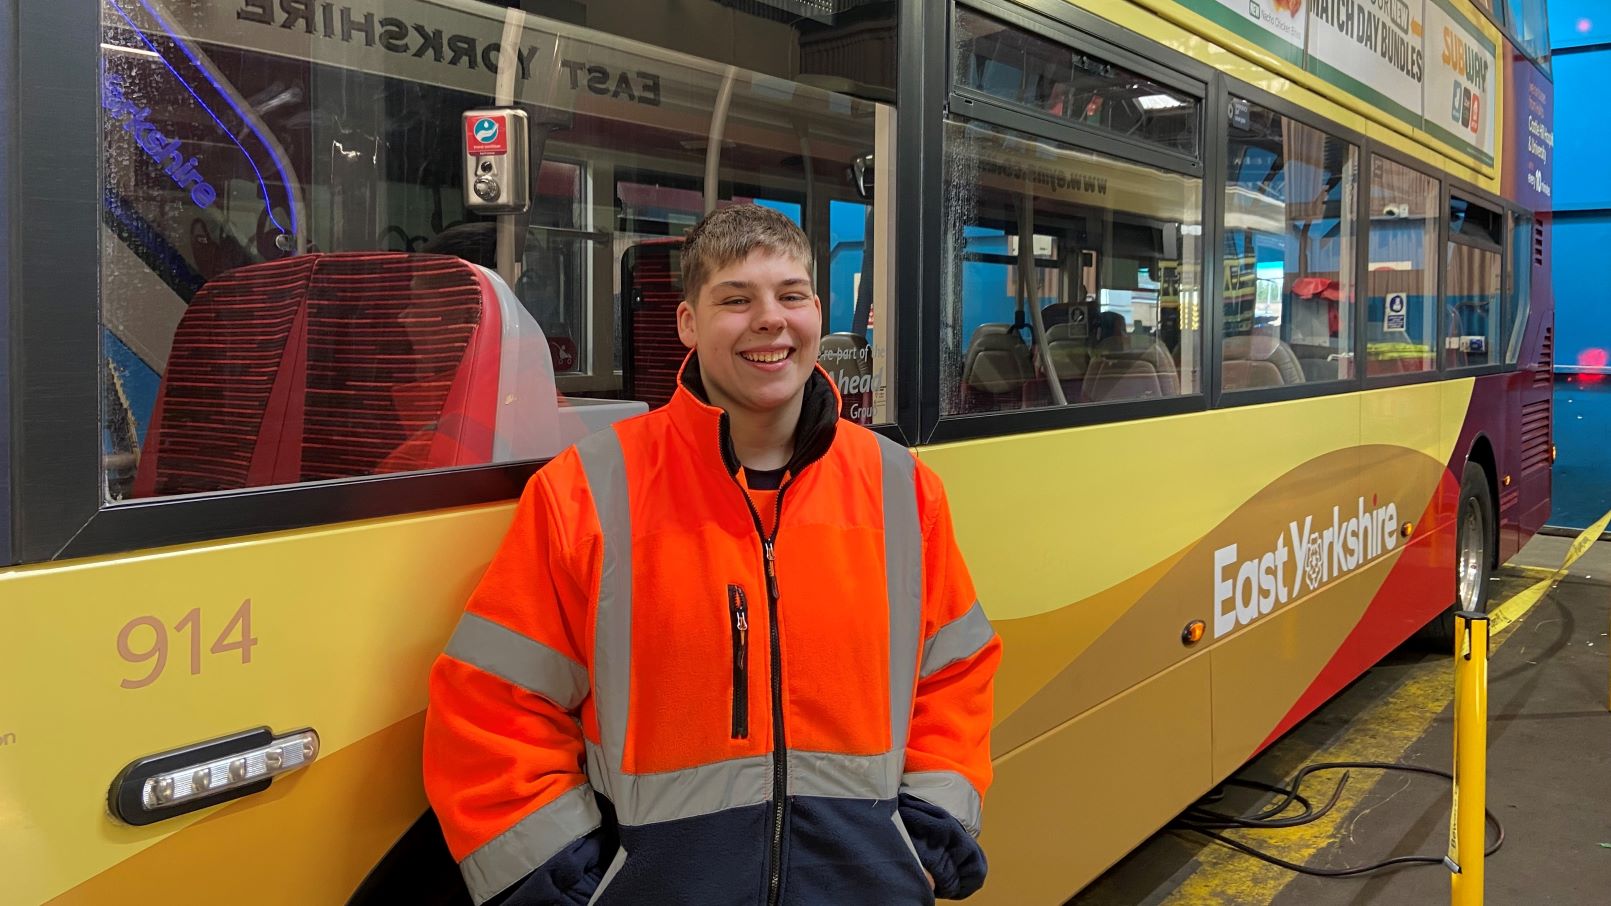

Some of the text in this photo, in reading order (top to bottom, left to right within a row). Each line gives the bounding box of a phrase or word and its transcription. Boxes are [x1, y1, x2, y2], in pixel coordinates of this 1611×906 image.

[1390, 0, 1408, 33] NEW
[1357, 3, 1379, 54] DAY
[1381, 20, 1422, 83] BUNDLES
[1442, 25, 1489, 93] SUBWAY
[1535, 169, 1542, 193] 10
[836, 345, 857, 365] part
[859, 344, 869, 362] of
[850, 403, 878, 420] Group
[1214, 493, 1398, 639] East Yorkshire
[117, 598, 258, 689] 914
